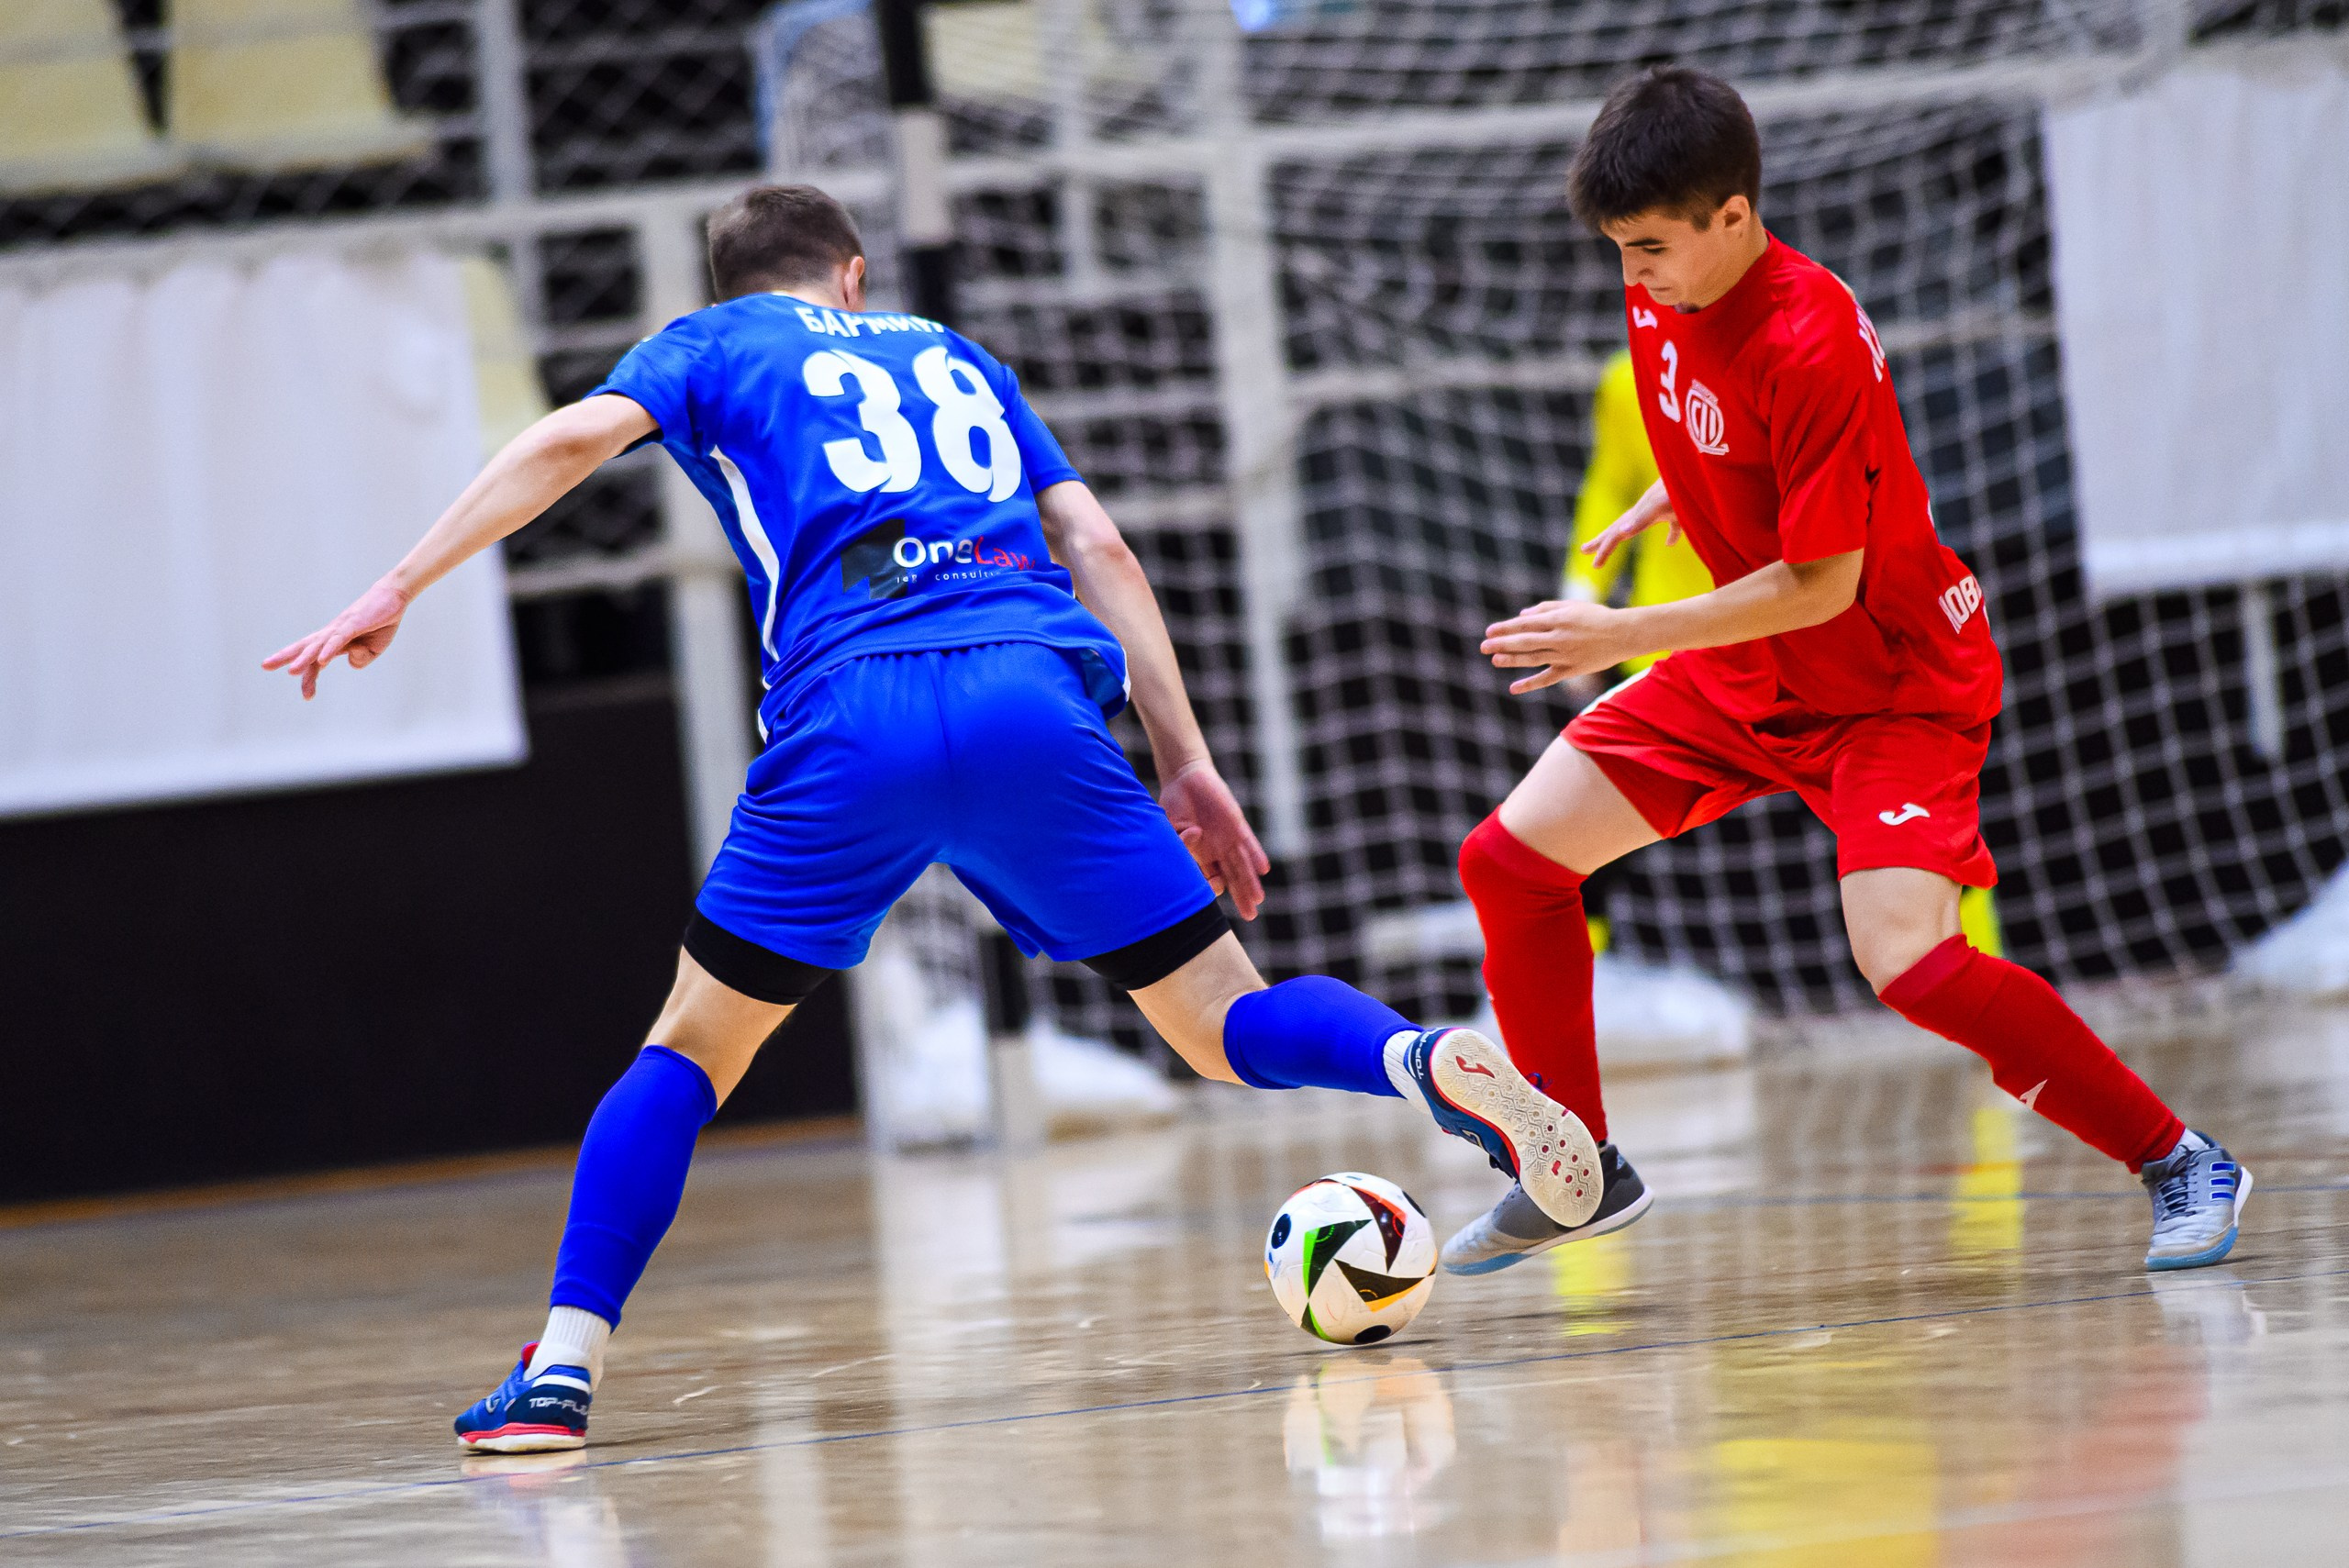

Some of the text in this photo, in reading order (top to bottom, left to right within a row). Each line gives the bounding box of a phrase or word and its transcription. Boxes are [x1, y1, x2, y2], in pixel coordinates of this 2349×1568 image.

[1658, 339, 1681, 423] 3
[802, 345, 1021, 503] 38
[893, 536, 1036, 571] OneLaw
